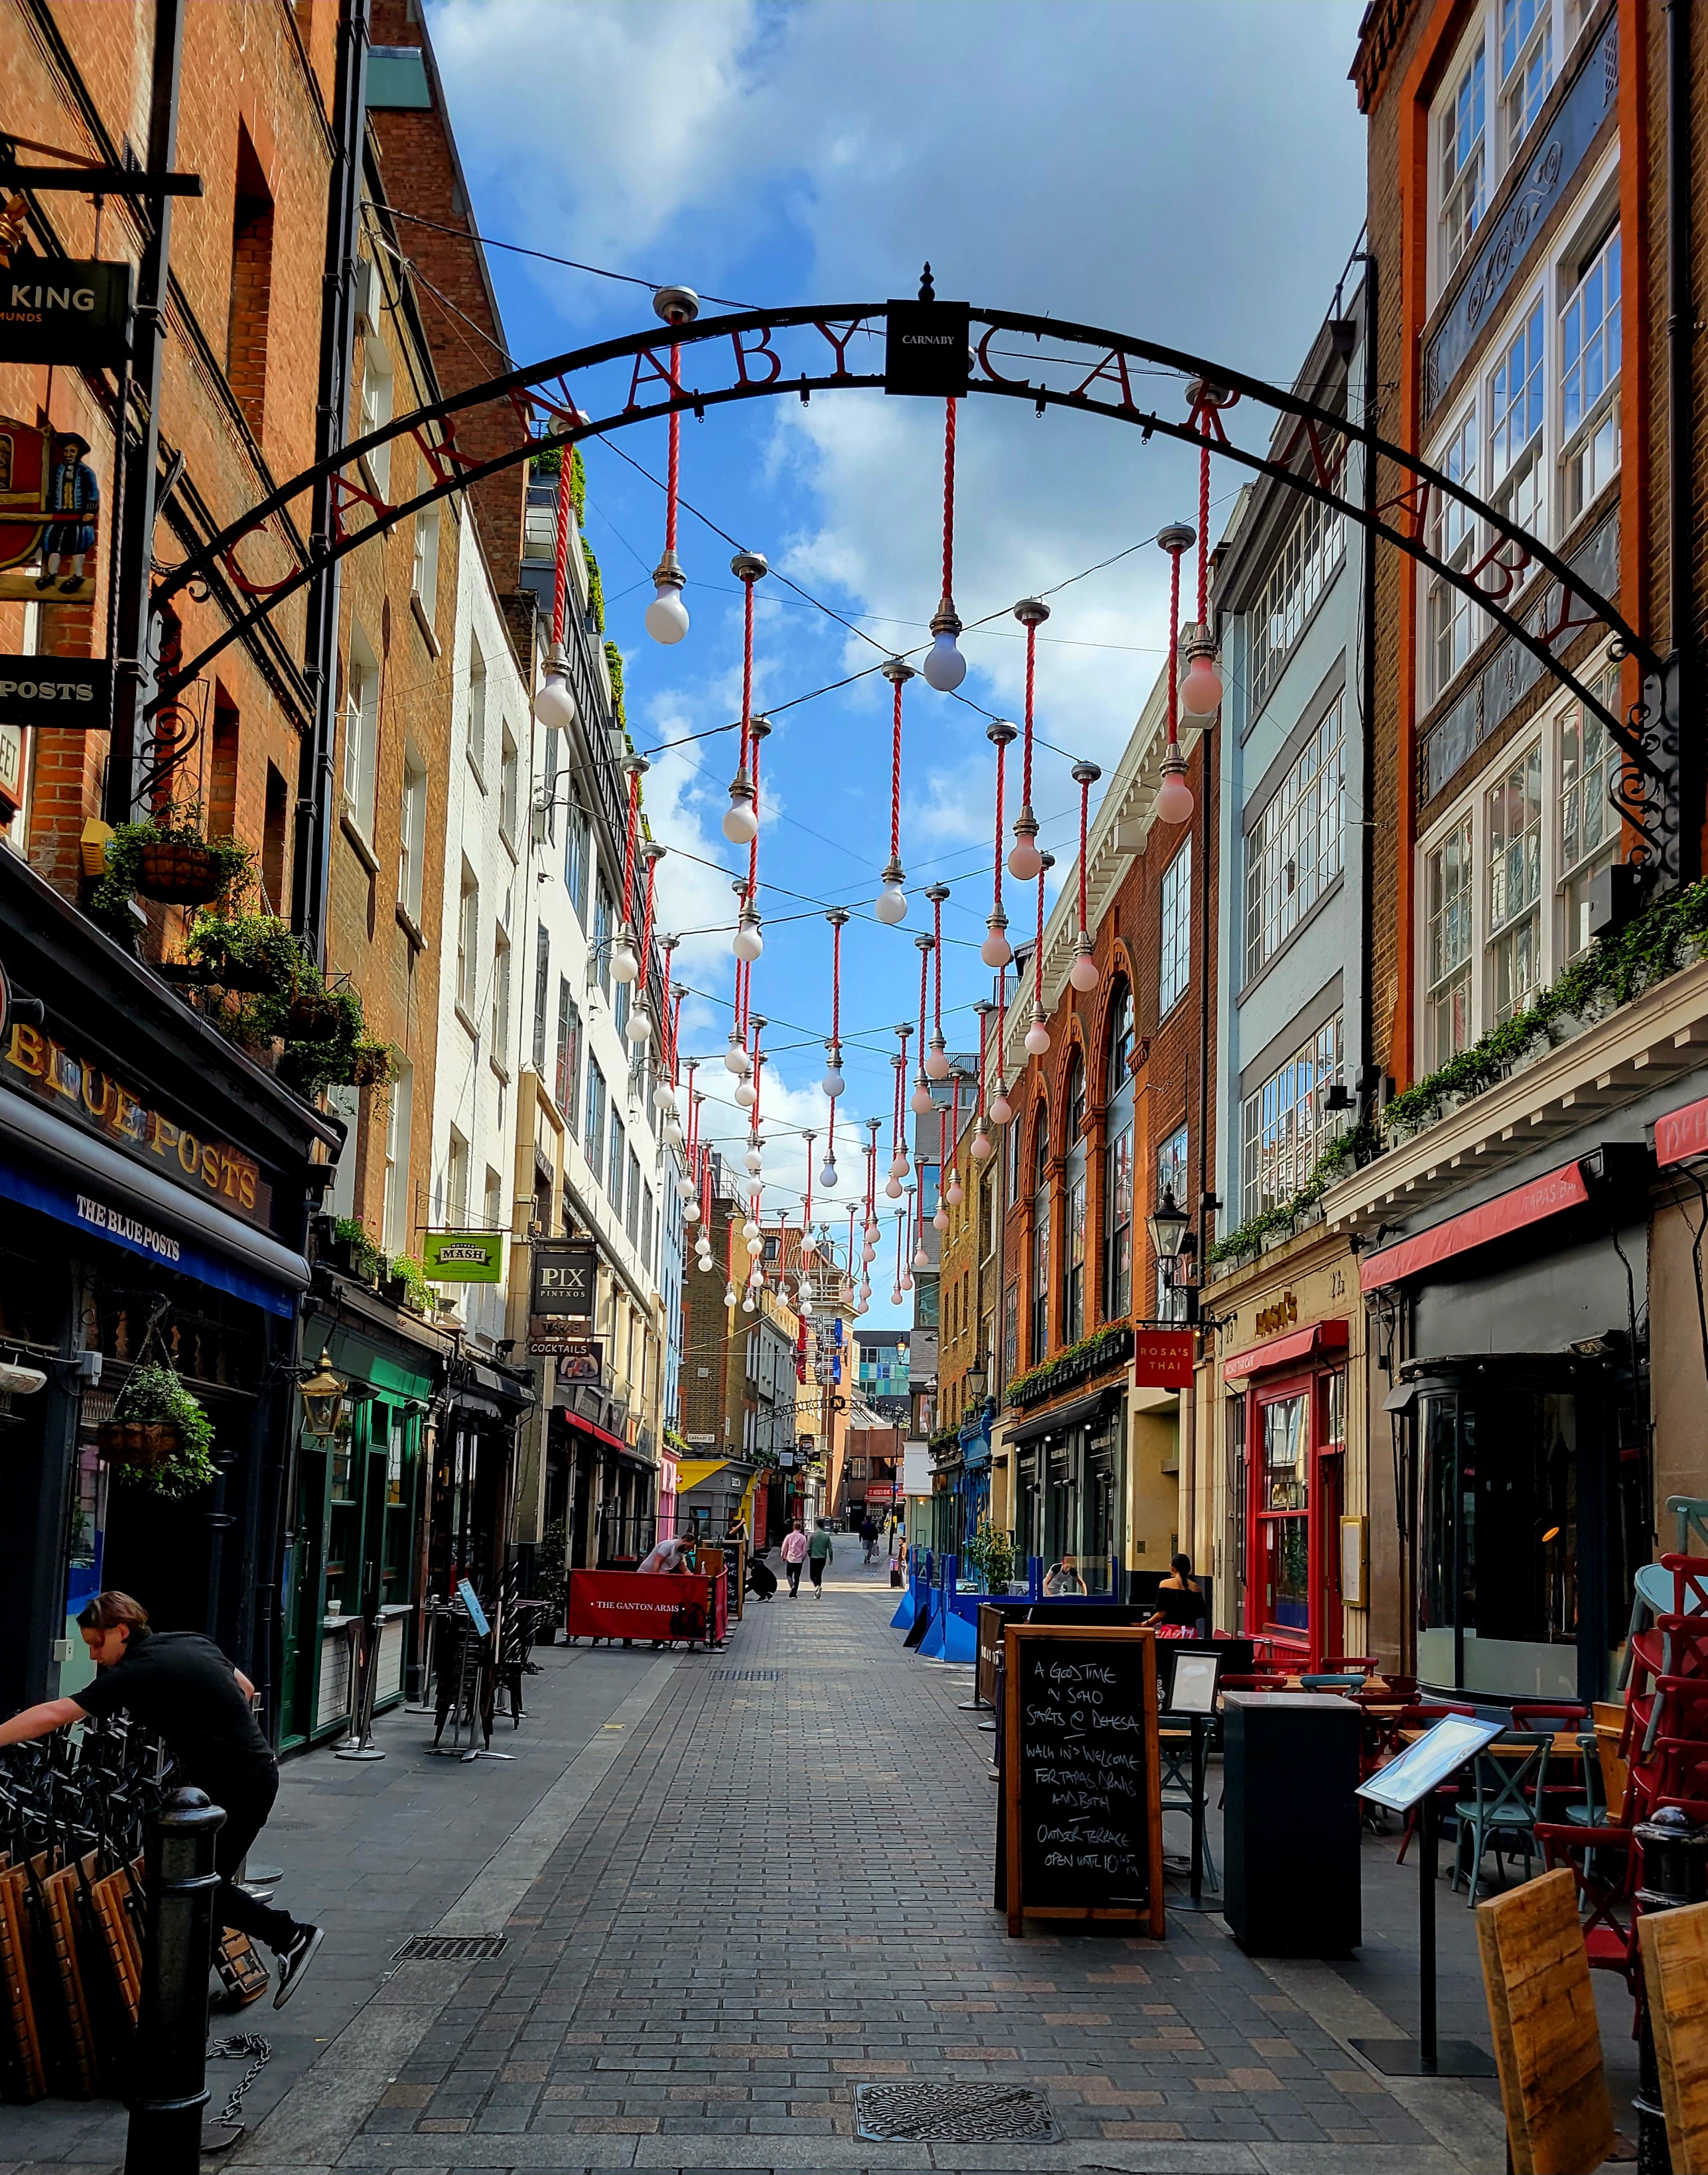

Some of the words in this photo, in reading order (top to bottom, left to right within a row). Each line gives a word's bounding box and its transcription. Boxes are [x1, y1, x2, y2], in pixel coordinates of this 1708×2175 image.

[11, 285, 95, 311] KING
[901, 335, 954, 345] CARNABY
[0, 680, 94, 701] POSTS
[5, 1023, 142, 1140] BLUE
[151, 1110, 257, 1209] POSTS
[76, 1194, 106, 1227] THE
[107, 1209, 144, 1244] BLUE
[143, 1230, 180, 1262] POSTS
[442, 1249, 484, 1260] MASH
[540, 1268, 586, 1287] PIX
[531, 1343, 587, 1354] COCKTAILS
[1140, 1347, 1189, 1356] ROSA'S
[1149, 1362, 1180, 1370] THAI
[596, 1601, 615, 1609] THE
[616, 1602, 653, 1611] GANTON
[654, 1604, 679, 1613] ARMS
[1035, 1661, 1045, 1678] A
[1049, 1662, 1082, 1684] GOOD
[1079, 1664, 1117, 1683] TIME
[1068, 1687, 1103, 1704] SOHO
[1083, 1745, 1141, 1771] WELCOME
[1034, 1768, 1061, 1785] FOR
[1052, 1790, 1079, 1806] AND
[1078, 1791, 1111, 1816] BOTH
[1082, 1827, 1132, 1848] TERRACE
[1045, 1851, 1073, 1867] OPEN
[1077, 1854, 1102, 1868] UNTIL
